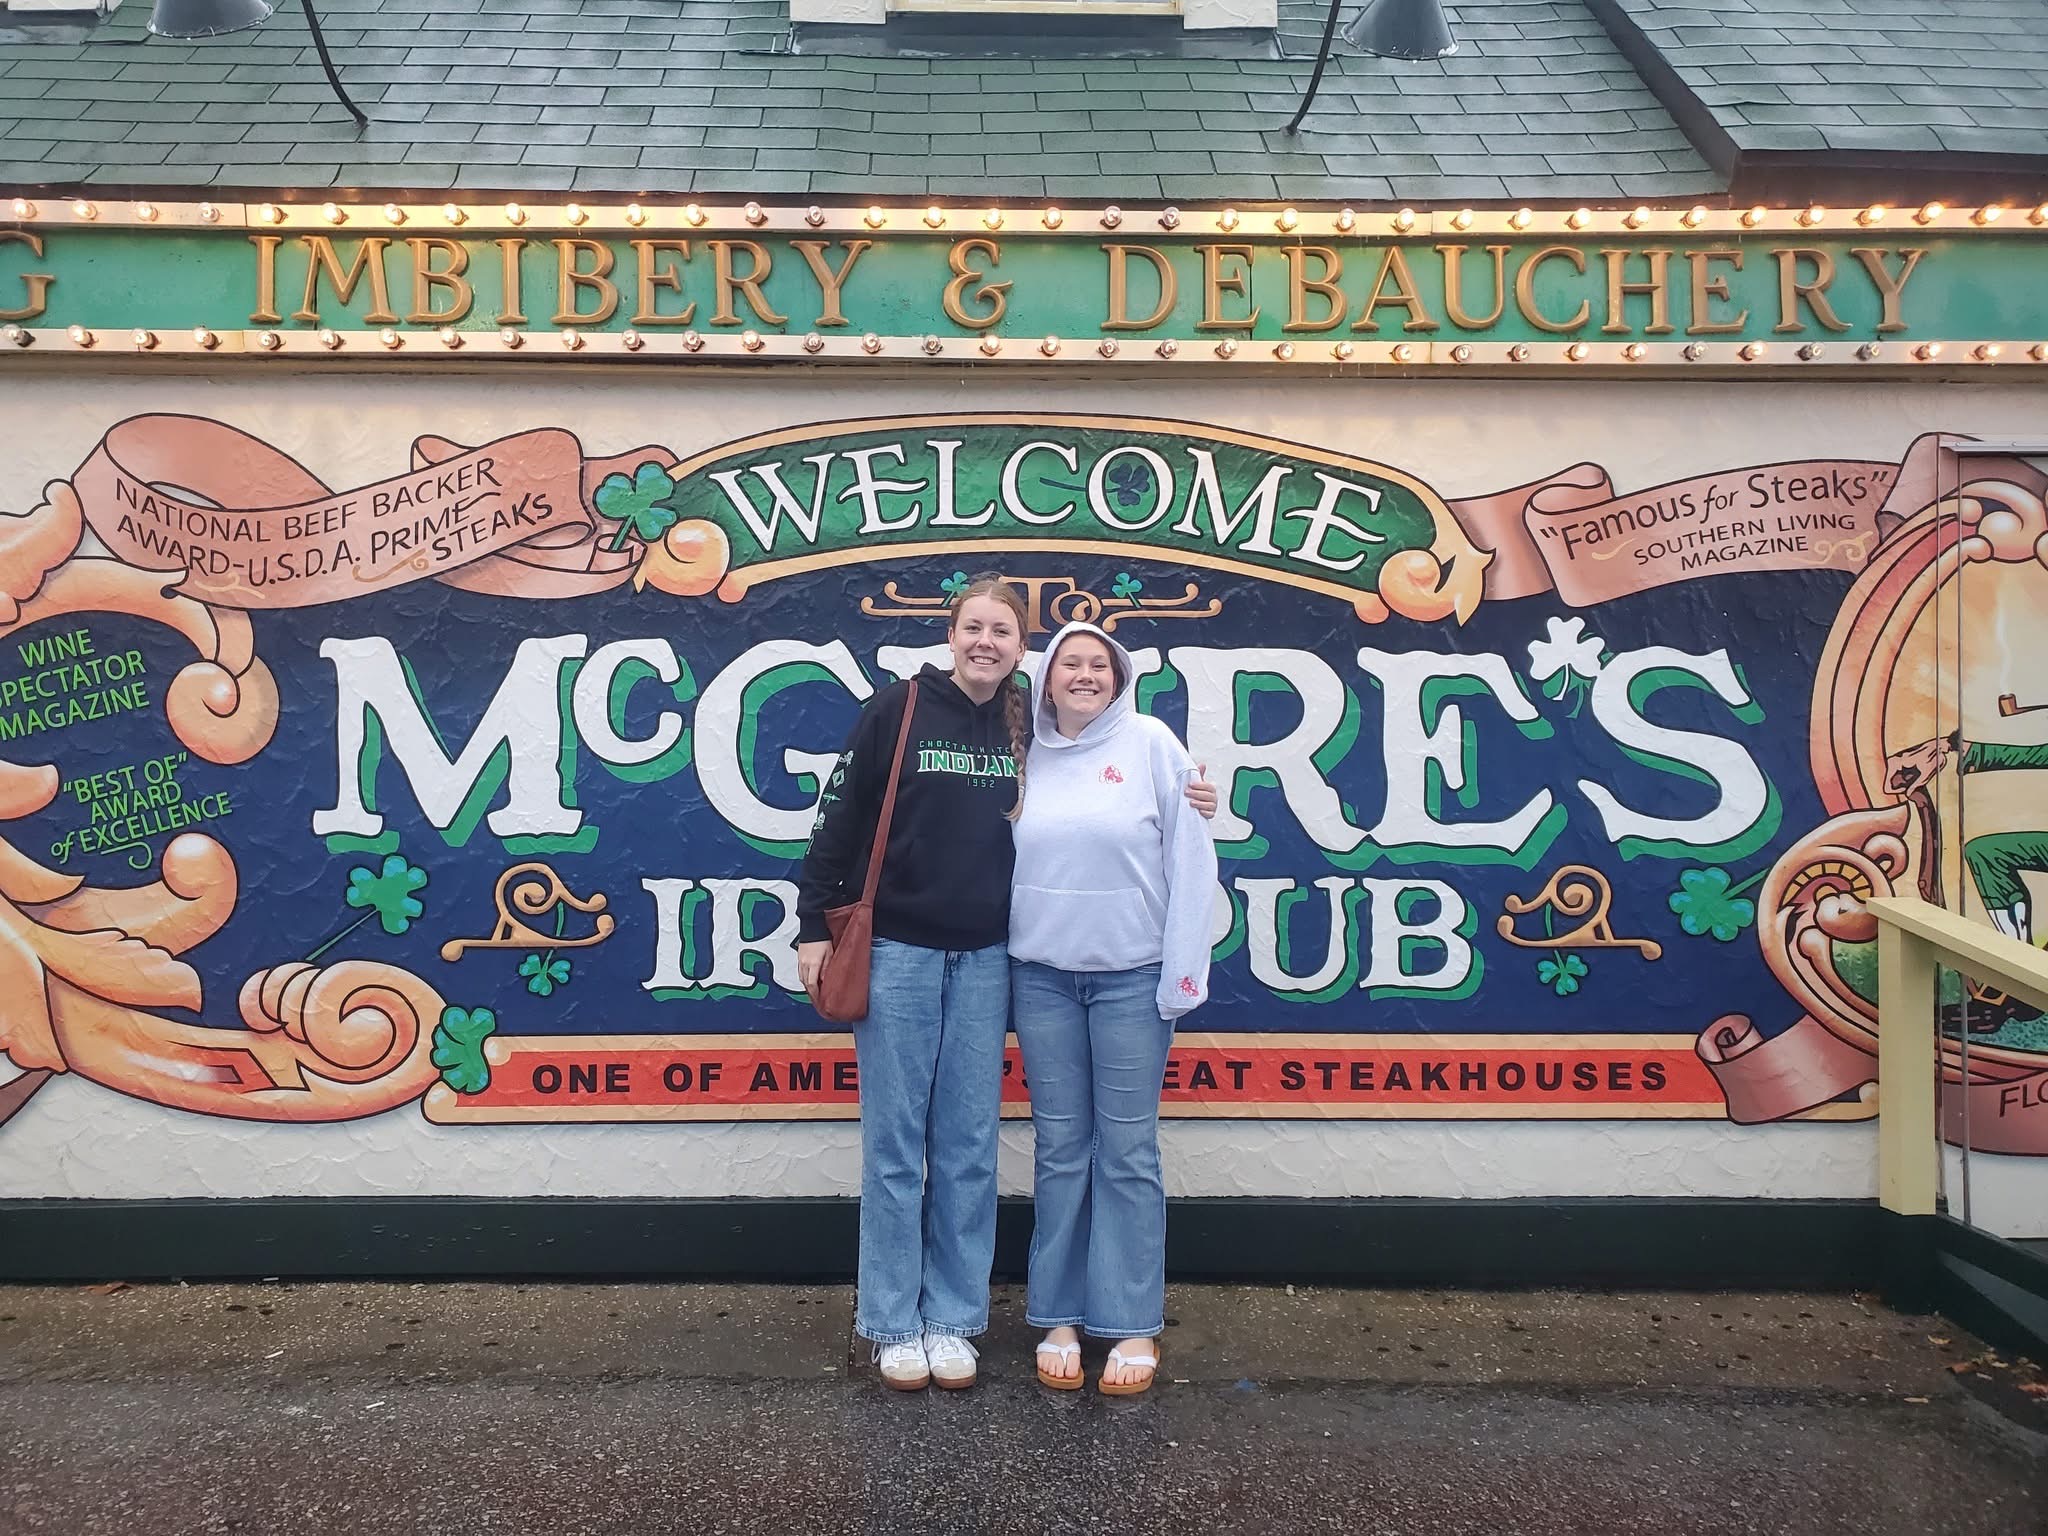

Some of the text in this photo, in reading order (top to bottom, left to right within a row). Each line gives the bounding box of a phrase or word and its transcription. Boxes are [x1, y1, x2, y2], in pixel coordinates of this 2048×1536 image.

[248, 235, 872, 327] IMBIBERY
[942, 238, 1013, 330] &
[1101, 243, 1928, 334] DEBAUCHERY
[115, 457, 502, 543] NATIONAL BEEF BACKER
[371, 492, 501, 564] PRIME
[432, 492, 553, 562] STEAKS
[709, 440, 1384, 573] WELCOME
[1539, 470, 1889, 560] "Famous for Steaks"
[1633, 513, 1856, 566] SOUTHERN LIVING
[1681, 536, 1809, 571] MAGAZINE
[18, 629, 95, 668] WINE
[0, 650, 147, 707] PECTATOR
[0, 682, 150, 741] MAGAZINE
[63, 752, 187, 804] "BEST OF"
[917, 750, 1018, 777] INDIAN
[967, 778, 995, 788] 1952
[51, 792, 233, 864] of EXCELLENCE
[91, 781, 182, 824] AWARD
[532, 1063, 631, 1093] ONE
[662, 1063, 722, 1092] OF
[1280, 1061, 1668, 1092] STEAKHOUSES
